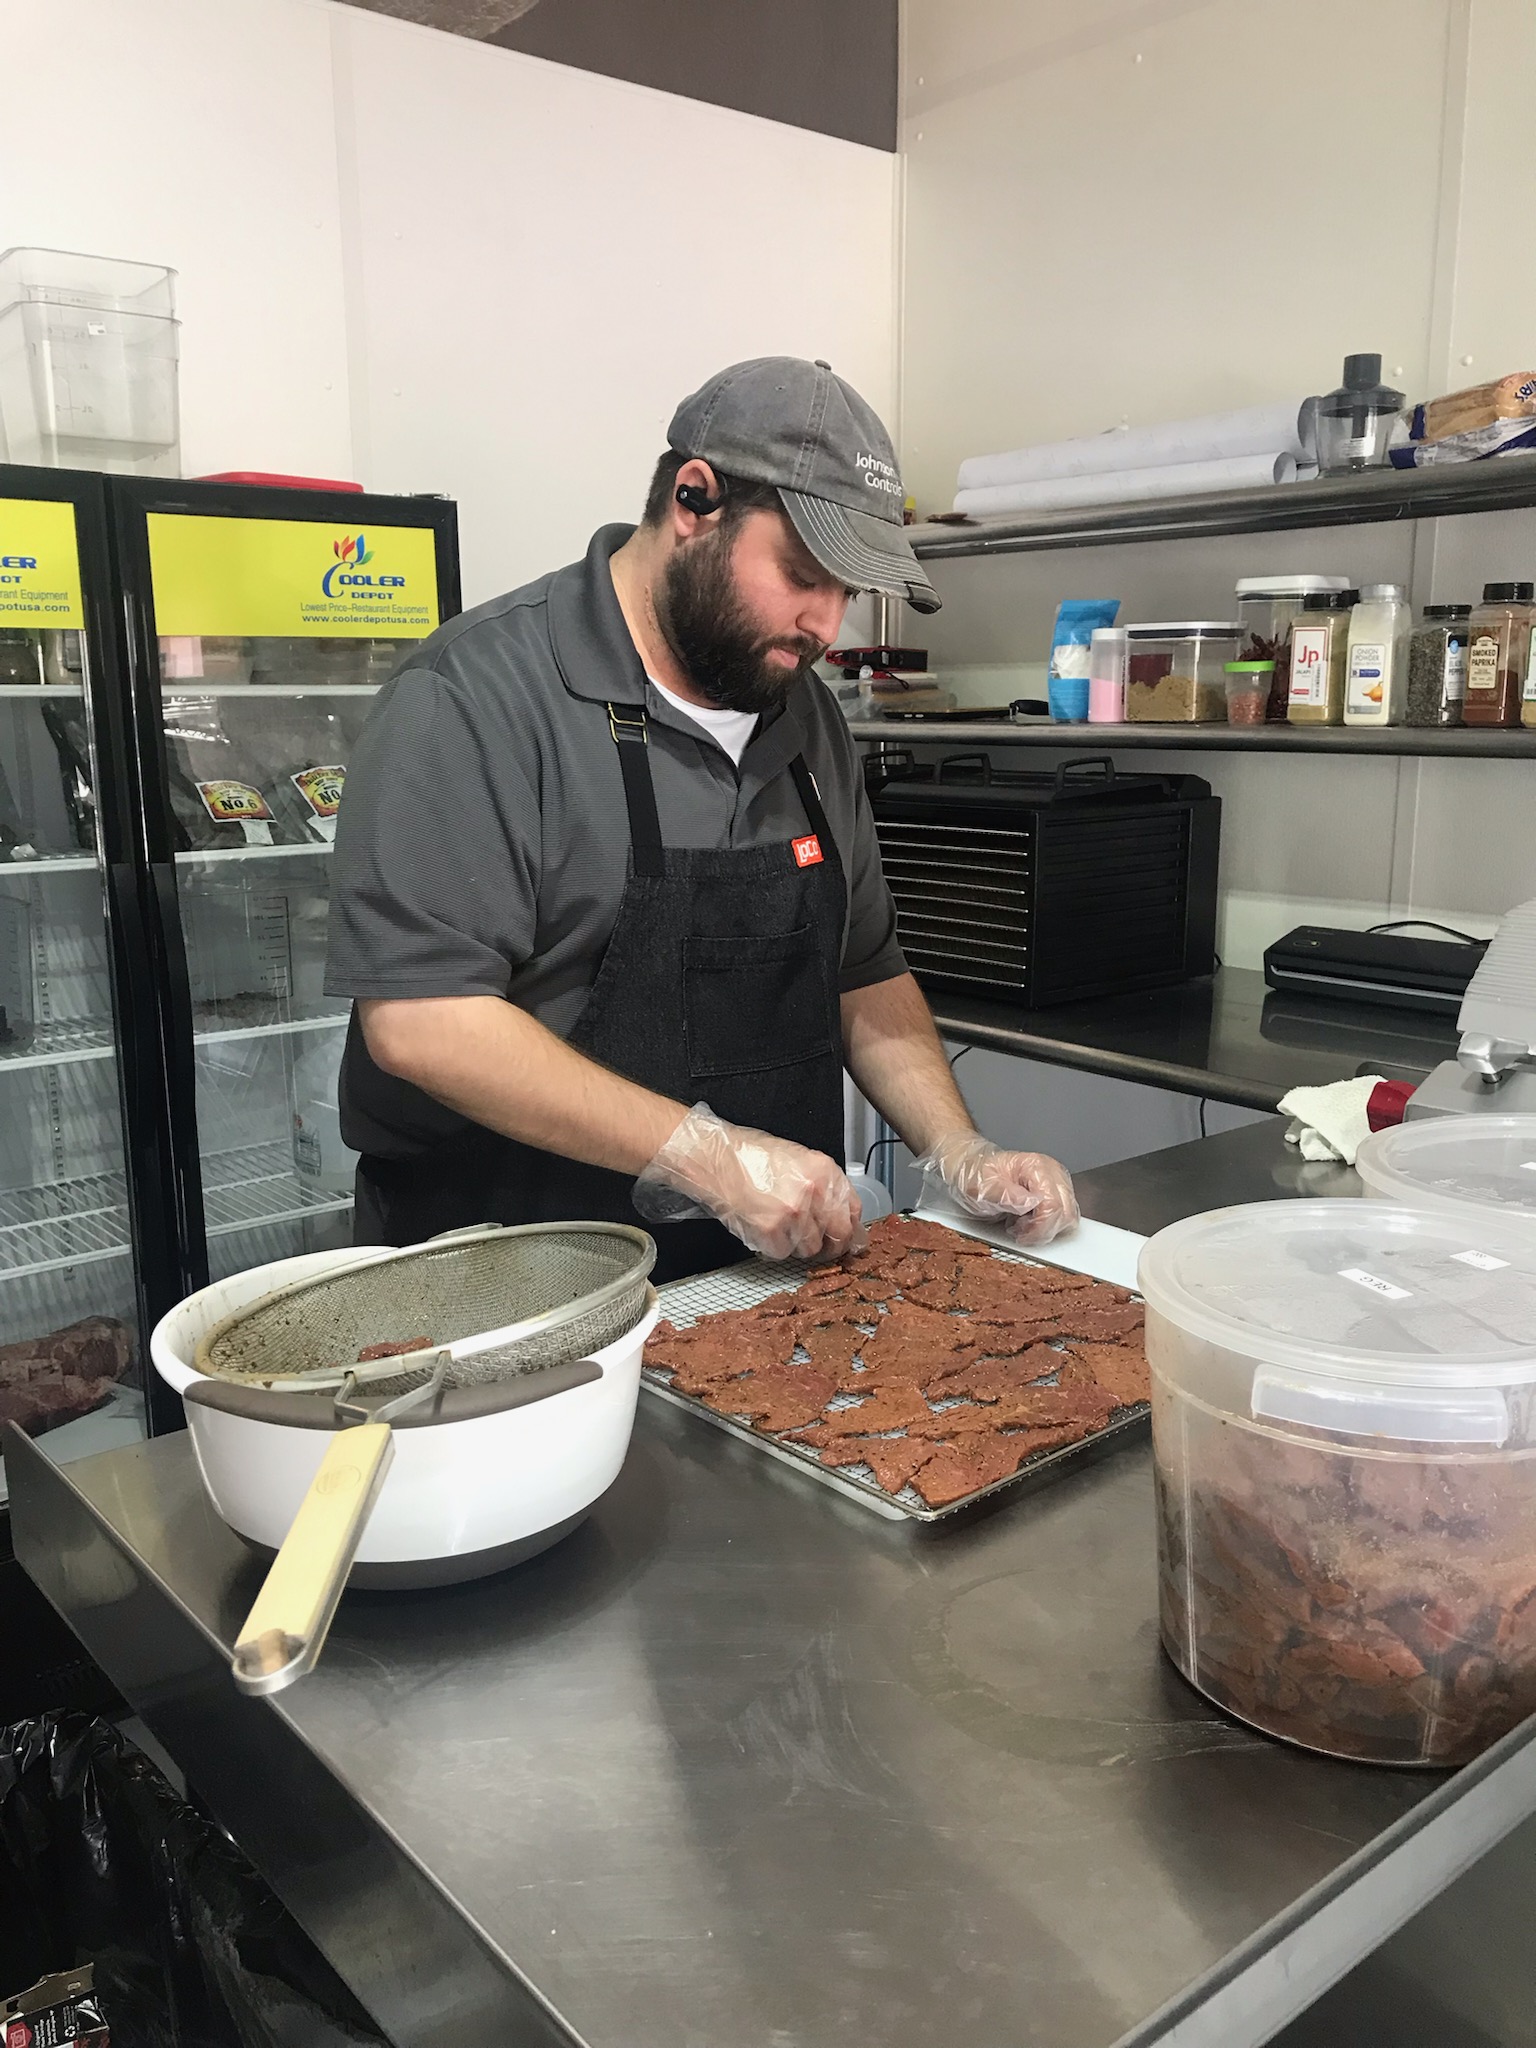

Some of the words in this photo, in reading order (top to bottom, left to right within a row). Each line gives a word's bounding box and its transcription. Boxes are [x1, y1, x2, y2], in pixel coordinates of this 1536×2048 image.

[855, 452, 896, 478] Johnson
[865, 472, 902, 497] Controls
[322, 561, 405, 598] COOLER
[20, 588, 69, 602] Equipment
[351, 591, 394, 600] DEPOT
[300, 602, 327, 613] Lowest
[392, 603, 428, 616] Equipment
[302, 614, 430, 625] www.coolerdepotusa.com
[1298, 645, 1319, 668] Jp
[1472, 649, 1496, 657] SMOKED
[1471, 659, 1496, 667] PAPRIKA
